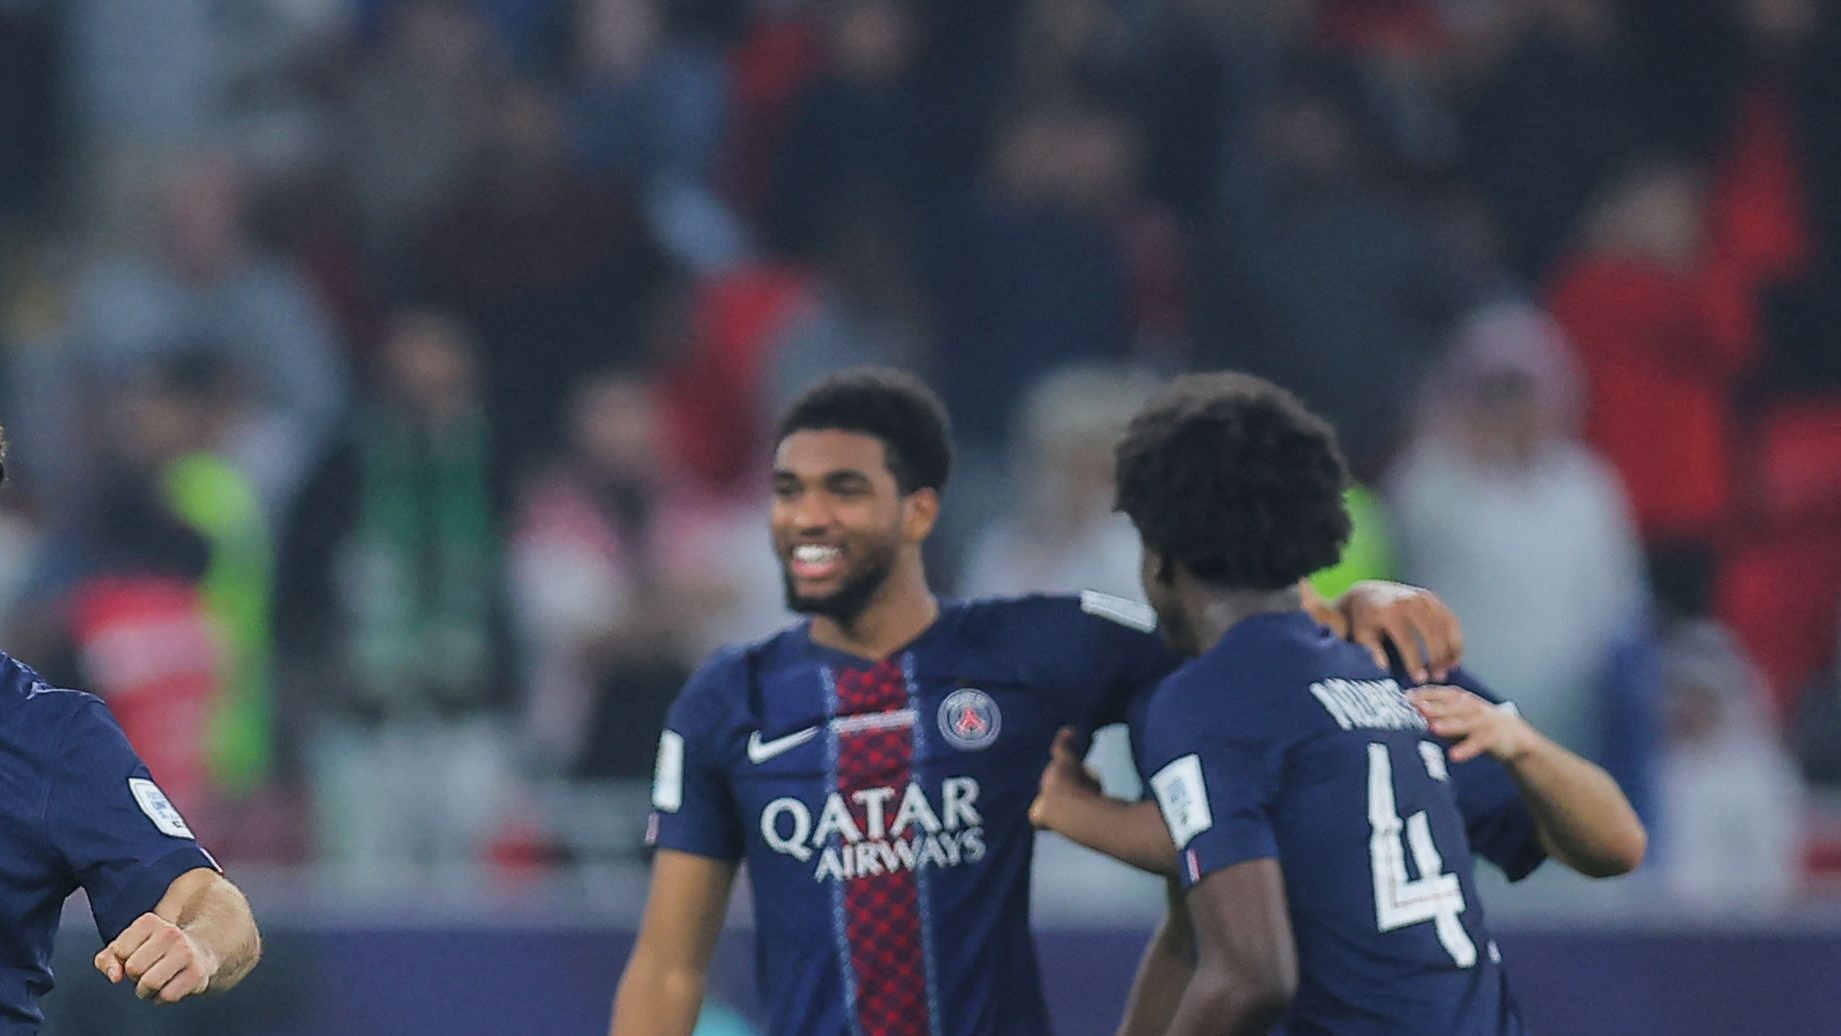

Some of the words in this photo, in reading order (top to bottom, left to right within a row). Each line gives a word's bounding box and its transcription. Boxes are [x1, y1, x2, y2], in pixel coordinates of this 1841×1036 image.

[760, 776, 983, 863] QATAR
[814, 826, 987, 883] AIRWAYS
[1367, 740, 1502, 968] 4
